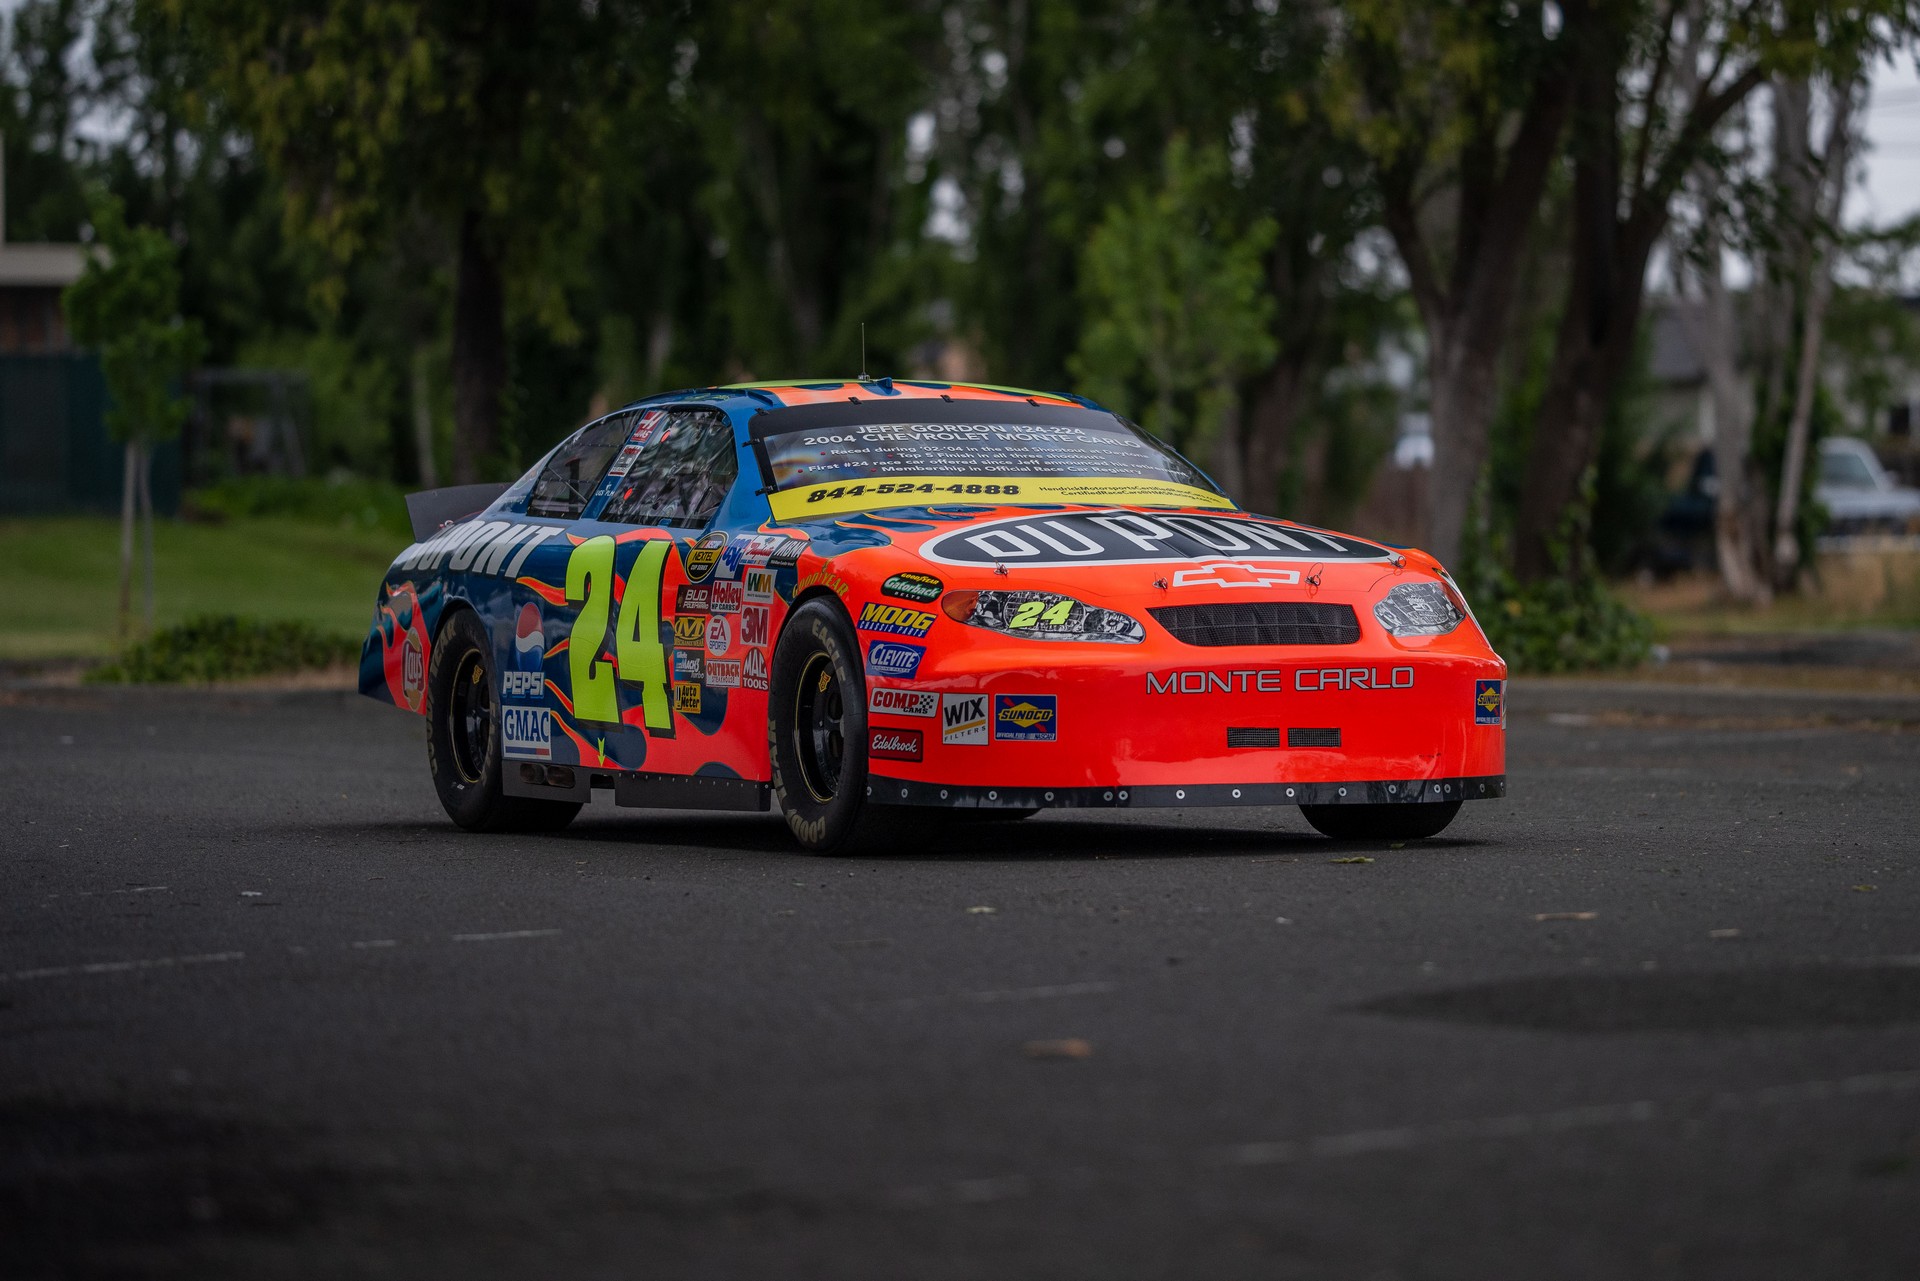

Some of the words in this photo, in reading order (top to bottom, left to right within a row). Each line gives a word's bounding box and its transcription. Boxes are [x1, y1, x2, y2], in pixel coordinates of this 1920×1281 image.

[855, 425, 906, 435] JEFF
[911, 424, 1006, 434] GORDON
[1011, 425, 1086, 436] #24-224
[803, 434, 857, 446] 2004
[862, 432, 990, 442] CHEVROLET
[995, 432, 1074, 443] MONTE
[1076, 434, 1141, 448] CARLO
[830, 447, 871, 455] Raced
[874, 445, 917, 453] during
[1031, 446, 1087, 454] Shootout
[1102, 448, 1150, 459] Daytona
[808, 463, 840, 472] First
[1043, 459, 1109, 467] announced
[881, 465, 966, 473] Membership
[1090, 466, 1142, 475] Registry
[806, 484, 1021, 503] 844-524-4888
[691, 551, 714, 562] NEXTEL
[747, 572, 772, 593] WM
[792, 572, 849, 598] GOODYEAR
[884, 577, 938, 598] Gatorback
[901, 573, 939, 585] GOODYEAR
[685, 590, 709, 602] BUD
[713, 582, 742, 611] Holley
[894, 591, 921, 600] BELTS
[718, 603, 736, 611] CARBS
[1009, 600, 1077, 629] 24
[860, 603, 937, 630] MOOG
[710, 618, 727, 641] EA
[742, 607, 769, 645] 3M
[860, 621, 894, 633] CHASSIS
[897, 626, 925, 637] PARTS
[565, 535, 677, 739] 24
[709, 641, 727, 651] SPORTS
[811, 618, 847, 683] EAGLE
[869, 643, 920, 668] CLEVITE
[707, 662, 740, 677] OUTBACK
[743, 648, 768, 679] MAC
[502, 671, 545, 698] PEPSI
[711, 676, 735, 684] STEAKHOUSE
[743, 677, 769, 691] TOOLS
[1146, 670, 1282, 694] MONTE
[1294, 666, 1415, 691] CARLO
[681, 686, 697, 697] Auto
[873, 690, 920, 709] COMP
[681, 696, 700, 708] Meter
[903, 706, 929, 715] CAMS
[944, 696, 986, 727] WIX
[1000, 709, 1052, 721] SUNOCO
[504, 709, 550, 743] GMAC
[944, 725, 986, 743] FILTERS
[872, 734, 918, 753] Edelbrock
[768, 718, 826, 843] GOODYEAR
